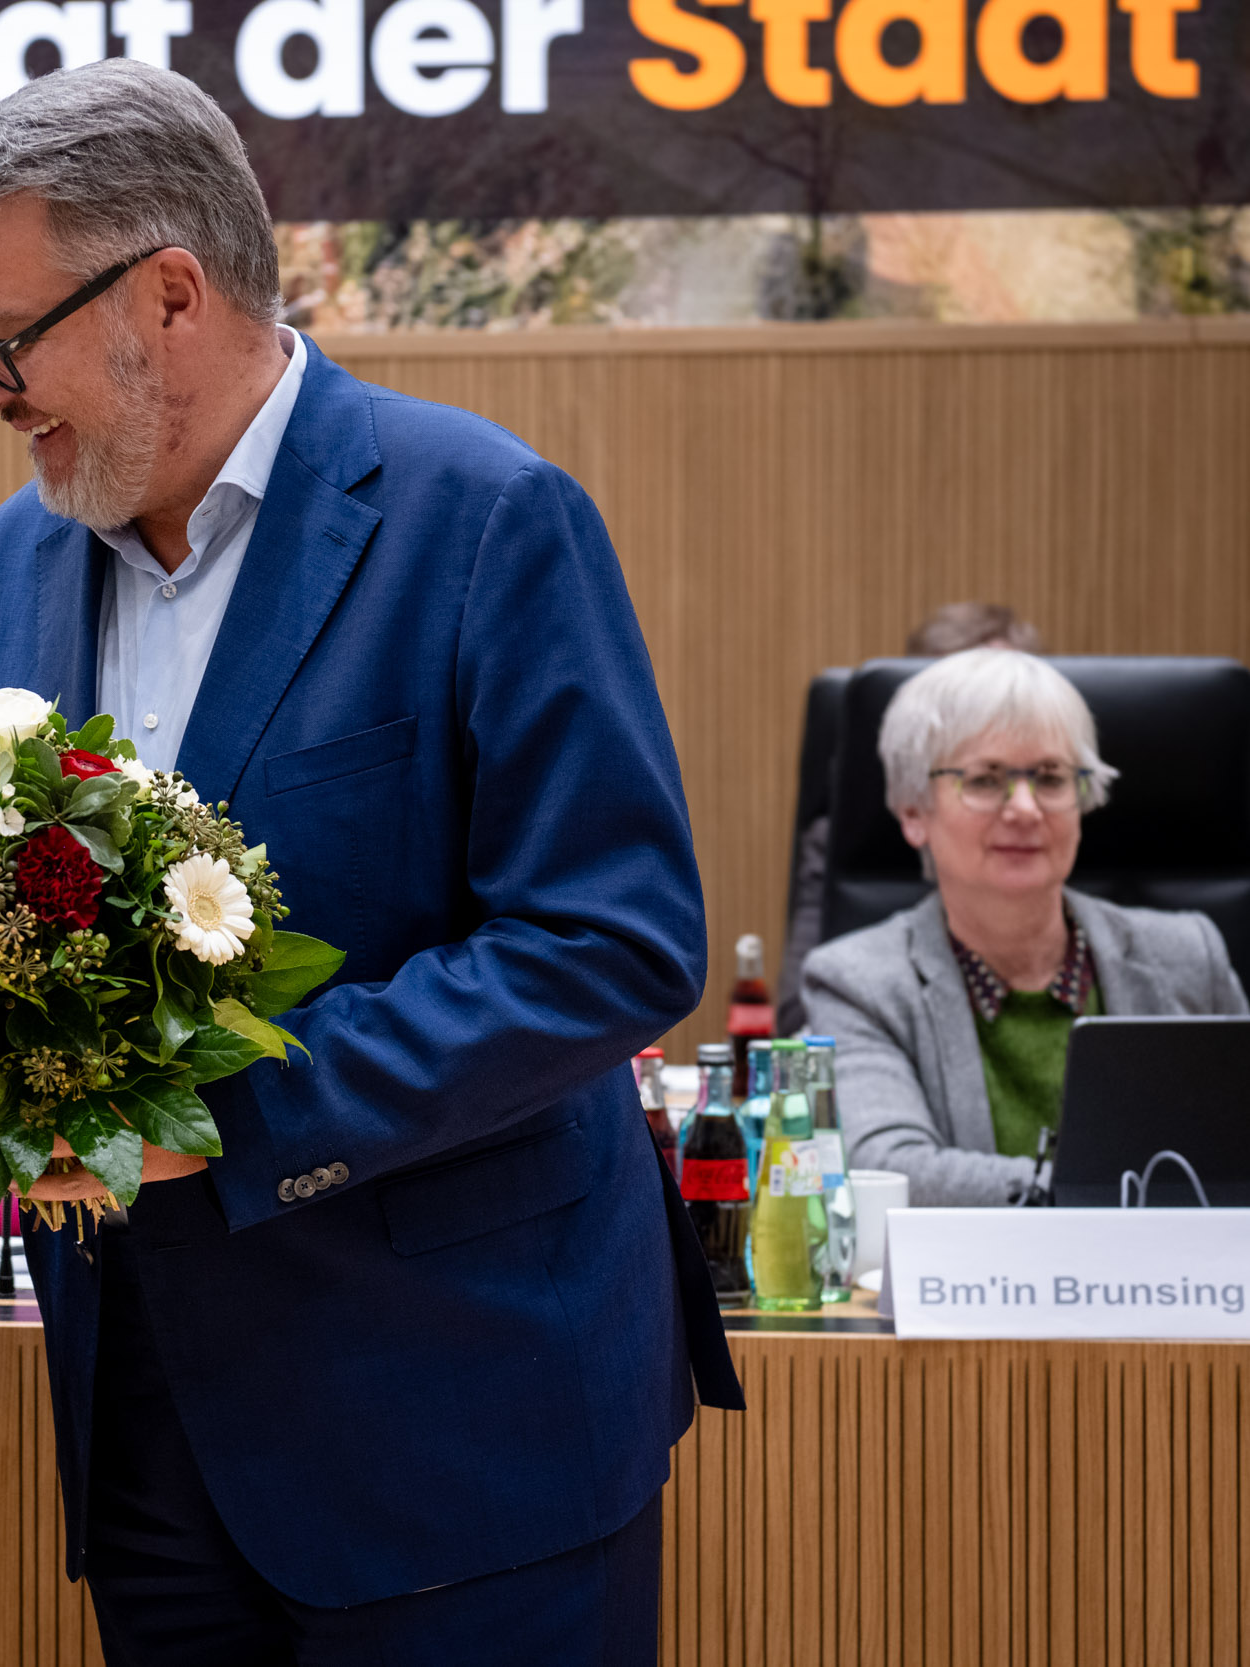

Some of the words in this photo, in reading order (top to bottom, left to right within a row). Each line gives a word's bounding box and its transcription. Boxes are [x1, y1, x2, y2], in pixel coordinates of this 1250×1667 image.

[234, 0, 584, 120] der
[919, 1276, 1037, 1305] Bm'in
[1053, 1276, 1244, 1314] Brunsing
